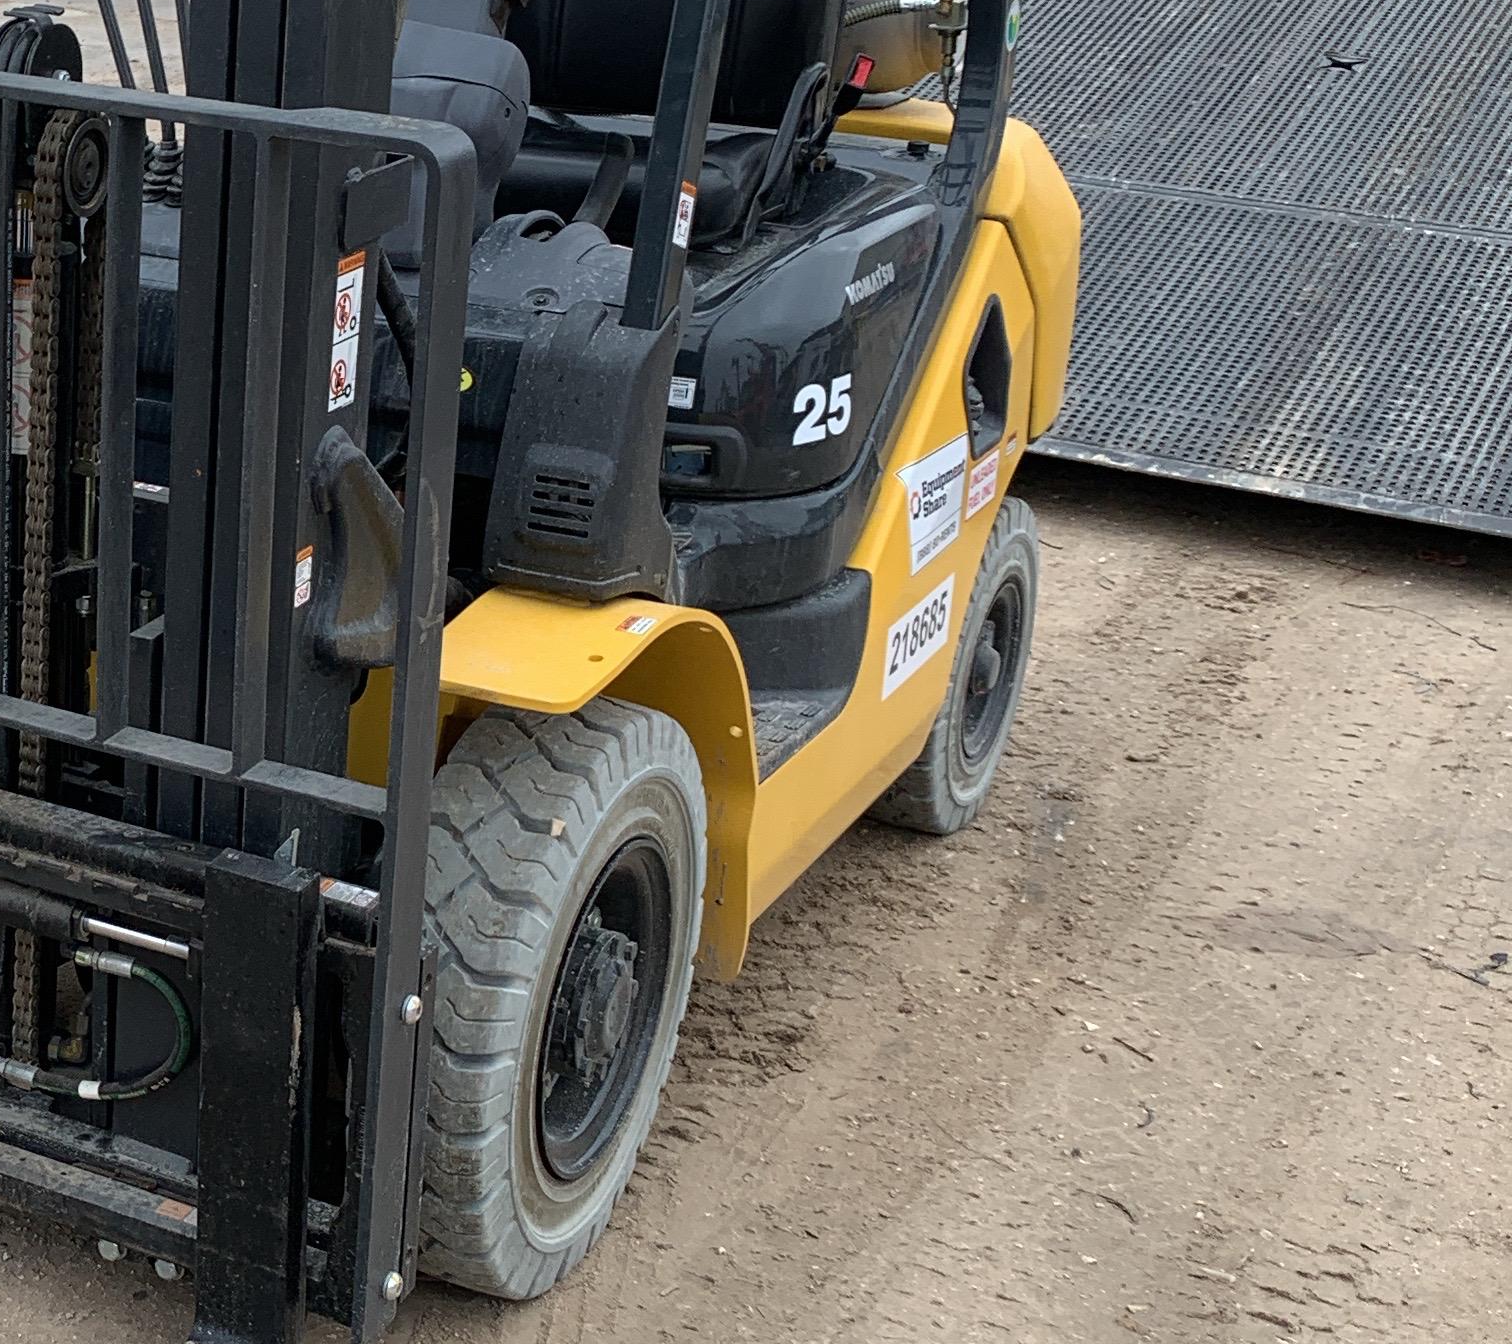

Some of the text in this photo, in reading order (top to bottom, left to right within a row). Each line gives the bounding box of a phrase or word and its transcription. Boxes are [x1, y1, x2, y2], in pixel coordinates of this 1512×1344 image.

[844, 261, 895, 305] KOMATSU
[792, 372, 852, 446] 25
[921, 459, 966, 499] Equipment
[922, 492, 948, 518] Share
[889, 590, 948, 676] 218685
